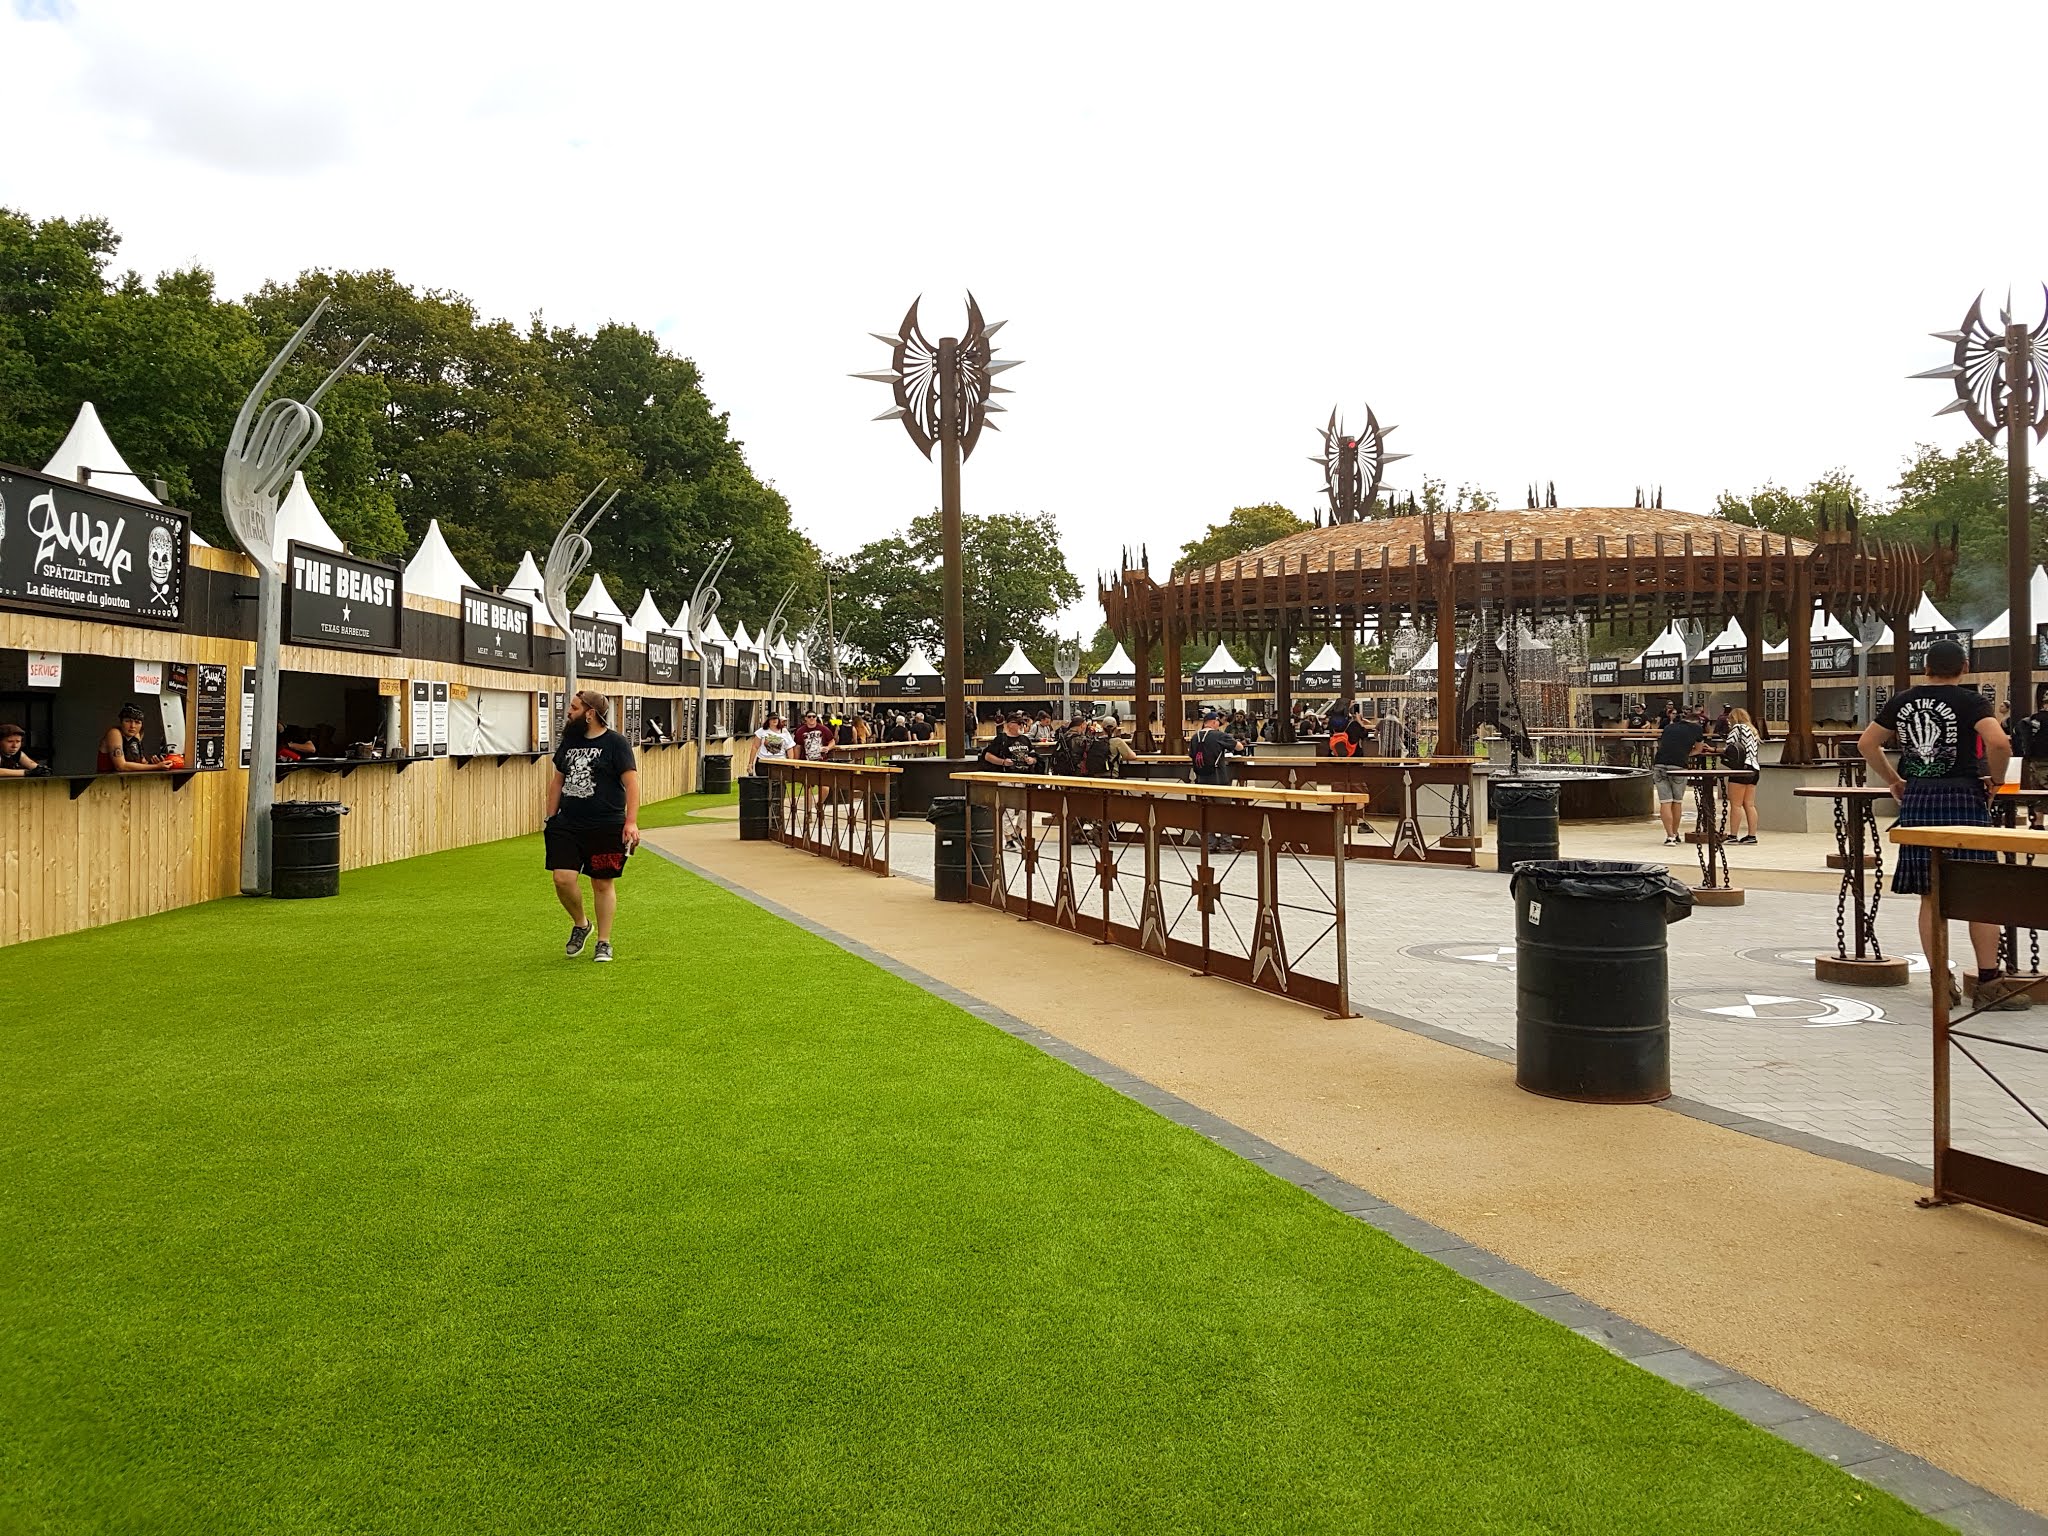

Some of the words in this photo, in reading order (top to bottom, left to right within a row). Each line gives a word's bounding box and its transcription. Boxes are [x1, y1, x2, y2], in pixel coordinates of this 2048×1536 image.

[78, 557, 87, 567] TA
[43, 563, 111, 587] SPÄTZIFLETTE
[293, 556, 332, 596] THE
[336, 566, 395, 608] BEAST
[26, 581, 39, 596] La
[40, 586, 86, 604] diététique
[86, 591, 98, 604] du
[100, 593, 131, 609] glouton
[464, 597, 489, 627] THE
[491, 604, 528, 635] BEAST
[320, 623, 340, 634] TEXAS
[340, 625, 370, 638] BARBECUE
[574, 625, 597, 658] FRENCH
[597, 628, 617, 656] CRÊPES
[648, 640, 665, 668] FRENCH
[1589, 661, 1617, 671] BUDAPEST
[1646, 657, 1679, 668] BUDAPEST
[1712, 664, 1742, 676] ARGENTINES
[30, 664, 59, 677] SERVICE
[1592, 674, 1598, 683] IS
[1599, 673, 1614, 683] HERE
[1650, 671, 1657, 680] IS
[1657, 670, 1674, 680] HERE
[136, 675, 160, 686] COMMANDE
[1914, 698, 1936, 709] THE
[1896, 702, 1915, 721] FOR
[1934, 701, 1958, 744] HOPLESS
[1896, 720, 1908, 744] HOPS
